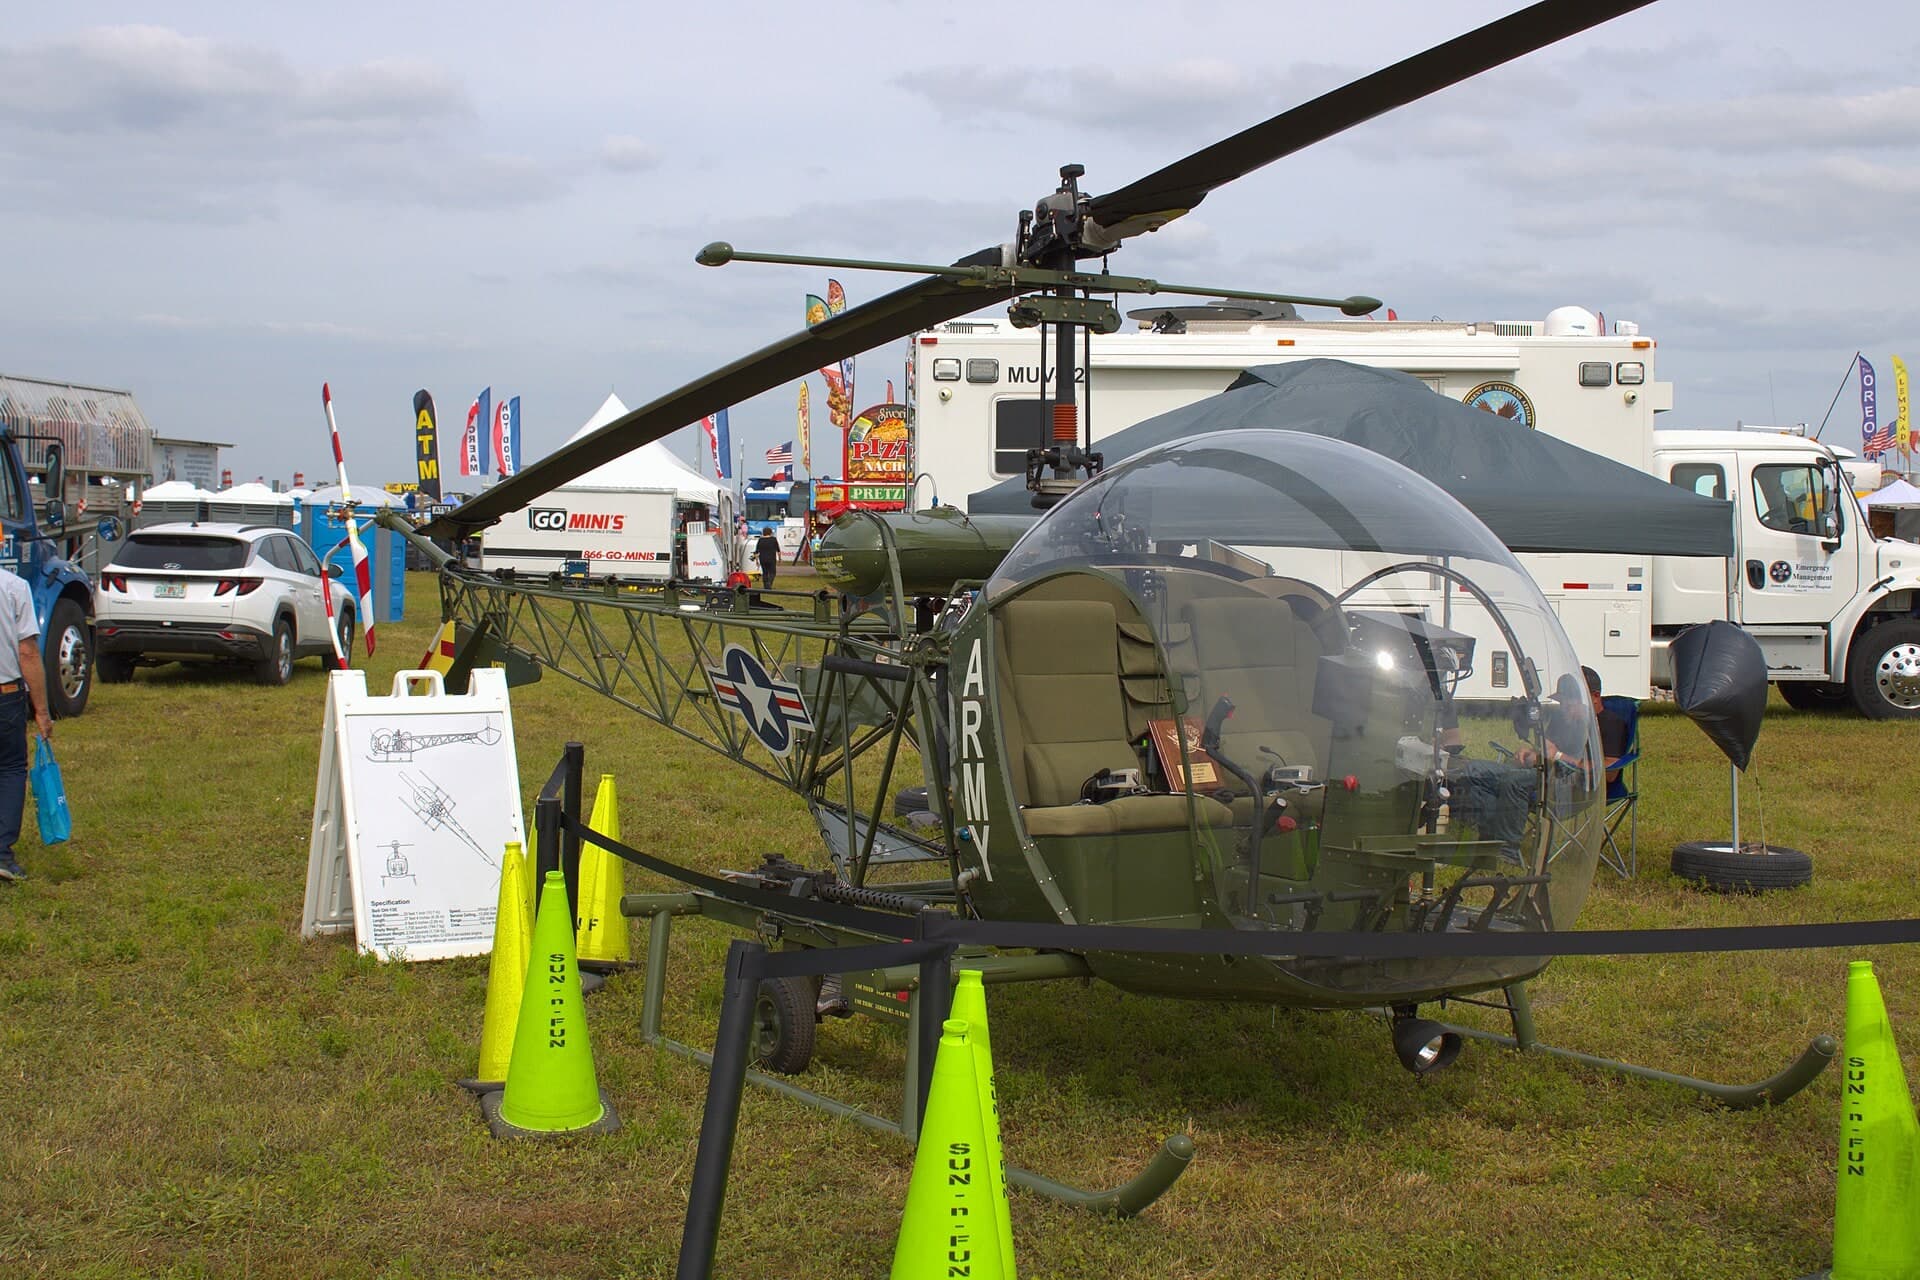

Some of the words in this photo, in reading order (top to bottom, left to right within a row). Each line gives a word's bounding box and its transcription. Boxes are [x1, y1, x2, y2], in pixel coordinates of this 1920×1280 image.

[1863, 374, 1875, 433] OREO
[1898, 378, 1907, 449] LEMONADE
[416, 409, 438, 480] ATM
[852, 438, 909, 461] PIZZ
[864, 461, 906, 472] NACH
[853, 488, 905, 500] PRETZ
[534, 511, 567, 528] GO
[568, 513, 625, 530] MINI'S
[583, 550, 655, 561] 866-GO-MINIS
[1795, 564, 1829, 572] Emergency
[962, 638, 993, 882] ARMY
[371, 899, 411, 907] Specification
